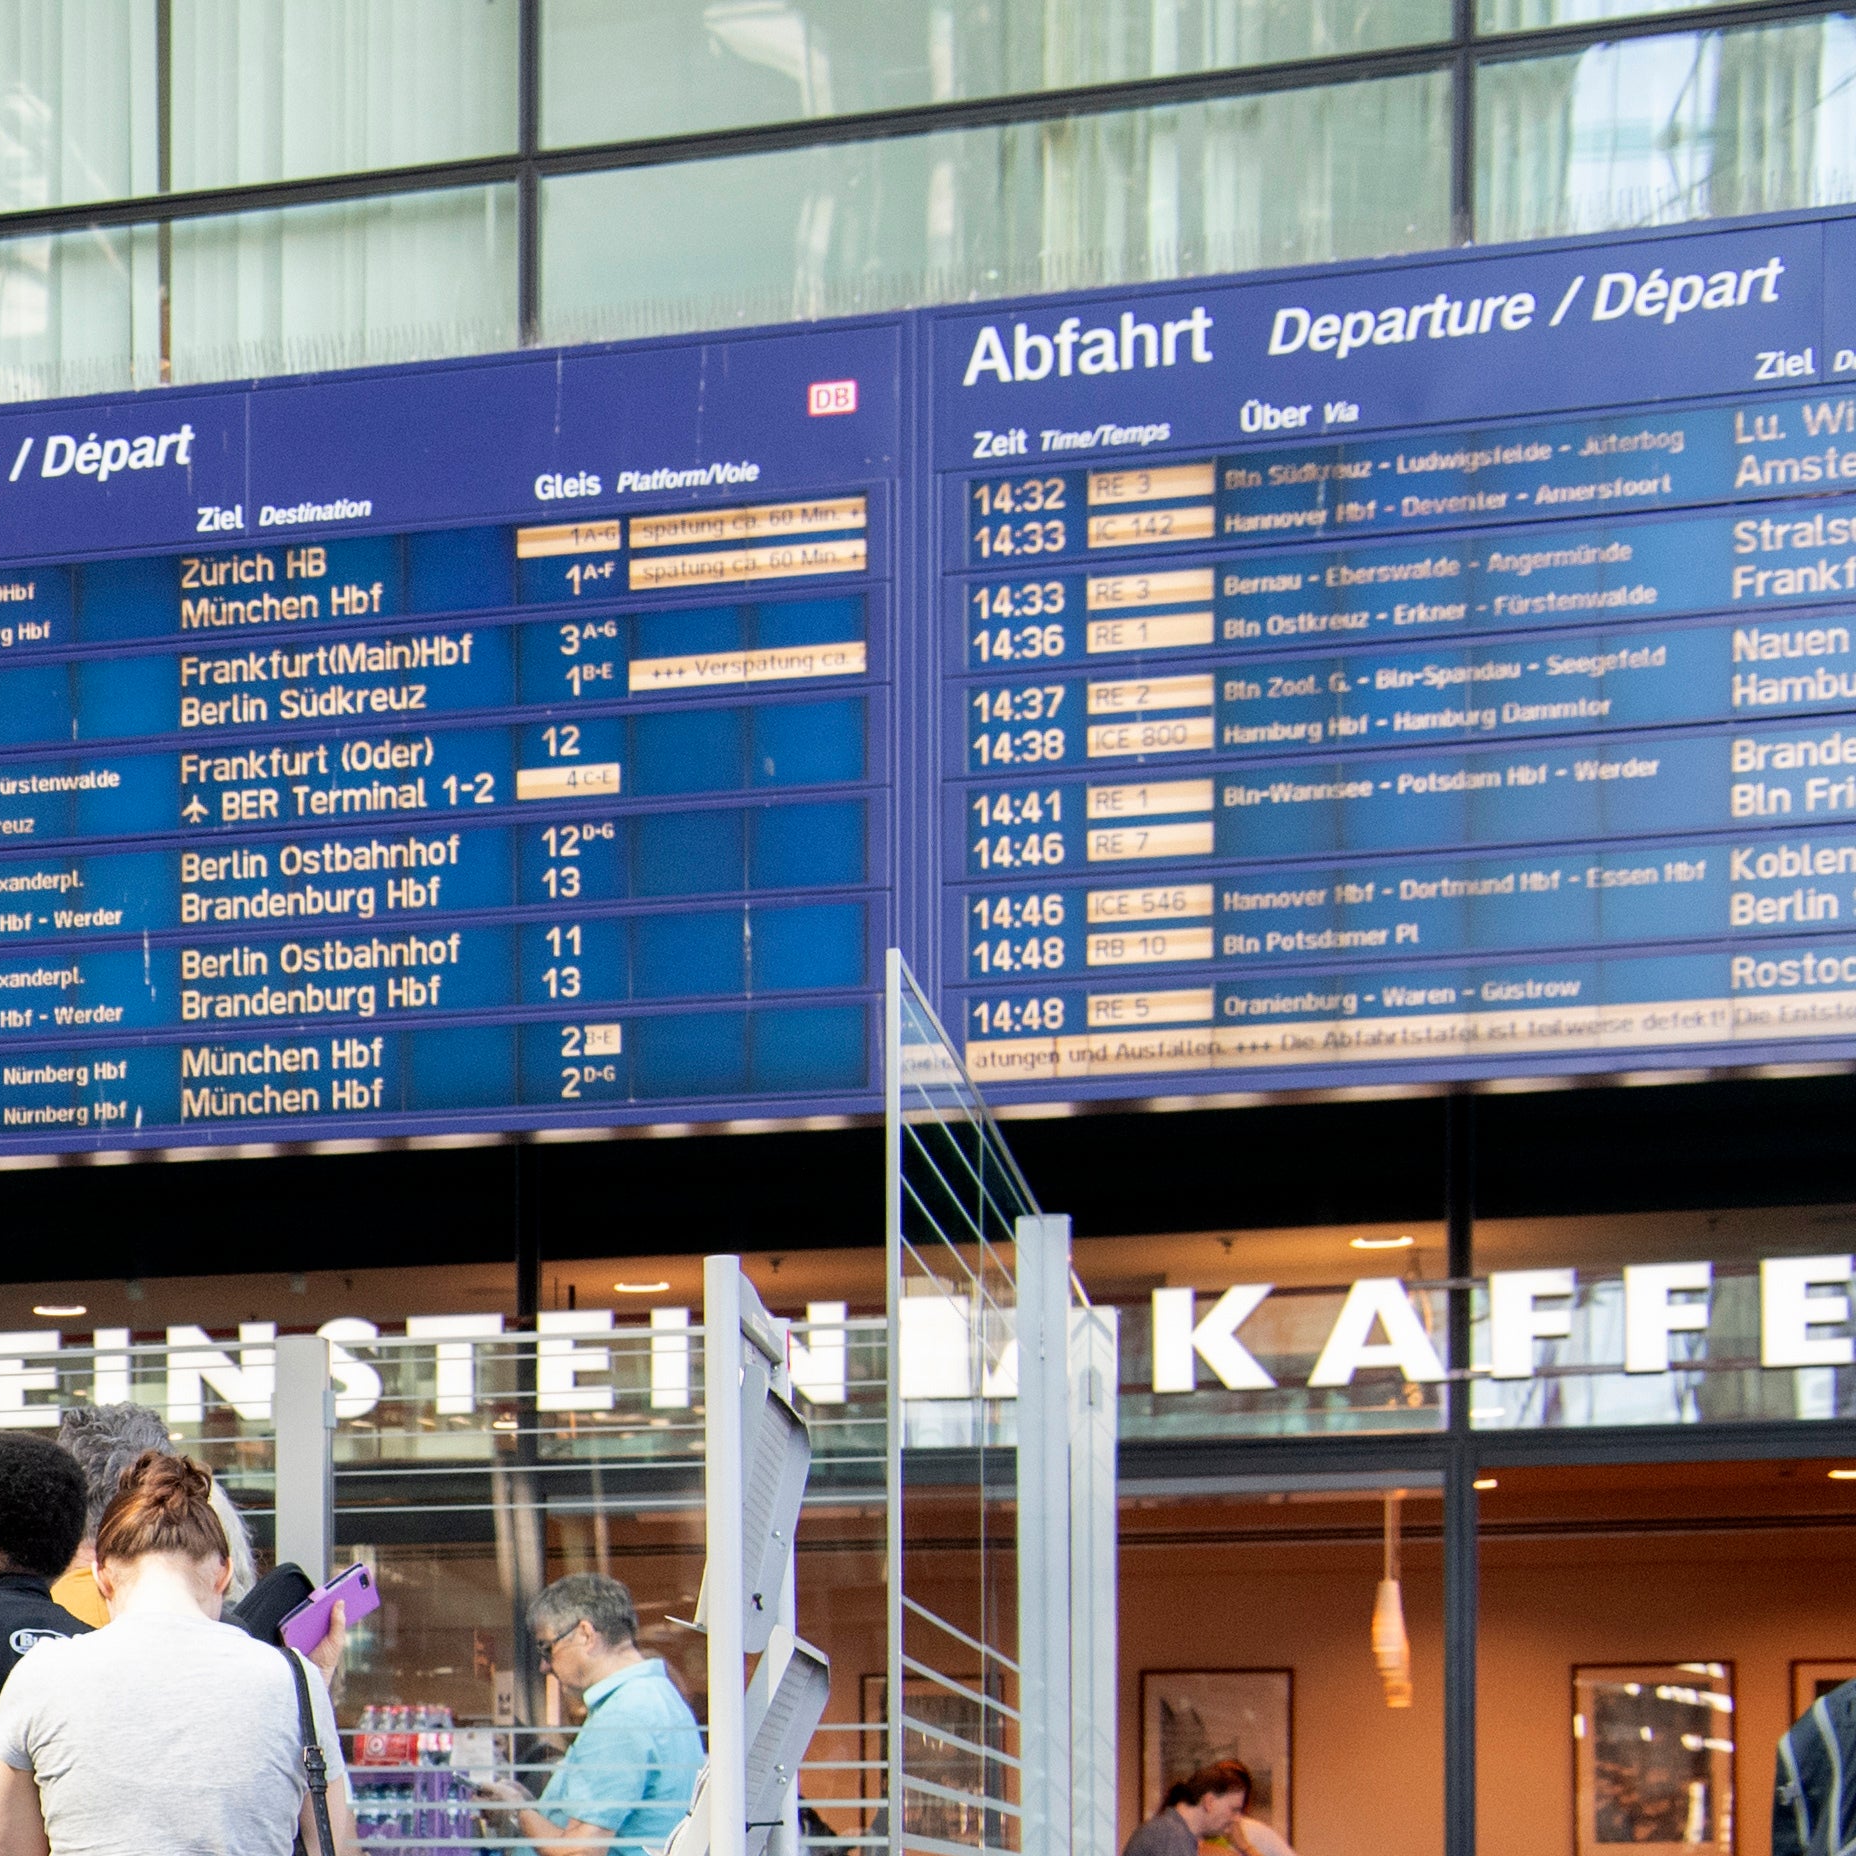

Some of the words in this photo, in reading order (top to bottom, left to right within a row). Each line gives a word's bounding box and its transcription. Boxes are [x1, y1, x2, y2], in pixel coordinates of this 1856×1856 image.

[963, 306, 1213, 386] Abfahrt
[1268, 290, 1536, 359] Departure
[1592, 257, 1785, 324] Départ
[1755, 349, 1816, 381] Ziel
[972, 428, 1028, 459] Zeit
[1040, 423, 1172, 452] Time/Temps
[1240, 399, 1312, 433] Über
[1324, 402, 1360, 424] Via
[41, 424, 195, 482] Départ
[535, 471, 602, 500] Gleis
[617, 461, 760, 493] Platform/Voie
[973, 479, 1066, 515] 14:32
[1095, 478, 1124, 497] RE
[1138, 475, 1150, 493] 3
[196, 504, 244, 532] Ziel
[259, 499, 372, 527] Destination
[1096, 522, 1116, 540] IC
[1132, 516, 1174, 537] 142
[974, 520, 1066, 558] 14:33
[182, 554, 275, 588] Zürich
[287, 547, 327, 579] HB
[1488, 542, 1633, 575] Angermünde
[182, 592, 319, 629] München
[331, 582, 383, 616] Hbf
[973, 582, 1065, 620] 14:33
[1494, 585, 1658, 616] Fürstenwalde
[18, 621, 50, 640] Hbf
[973, 624, 1065, 662] 14:36
[1732, 626, 1850, 663] Nauen
[182, 633, 473, 687] Frankfurt(Main)Hbf
[181, 693, 267, 727] Berlin
[280, 684, 427, 719] Südkreuz
[973, 685, 1065, 723] 14:37
[542, 725, 580, 757] 12
[973, 729, 1065, 766] 14:38
[1096, 728, 1129, 749] ICE
[1143, 724, 1187, 747] 800
[181, 744, 328, 784] Frankfurt
[341, 737, 433, 772] (Oder)
[222, 788, 279, 822] BER
[293, 778, 427, 816] Terminal
[442, 772, 494, 805] 1-2
[973, 790, 1062, 827] 14:41
[181, 850, 267, 883] Berlin
[280, 834, 460, 876] Ostbahnhof
[973, 833, 1065, 869] 14:46
[181, 885, 375, 923] Brandenburg
[387, 876, 440, 909] Hbf
[542, 866, 581, 898] 13
[0, 913, 32, 931] Hbf
[54, 908, 122, 928] Werder
[973, 894, 1065, 931] 14:46
[1730, 888, 1838, 926] Berlin
[545, 925, 581, 957] 11
[973, 937, 1065, 973] 14:48
[542, 967, 581, 998] 13
[973, 997, 1065, 1034] 14:48
[3, 1064, 88, 1086] Nürnberg
[94, 1060, 127, 1079] Hbf
[182, 1043, 319, 1078] München
[332, 1037, 383, 1069] Hbf
